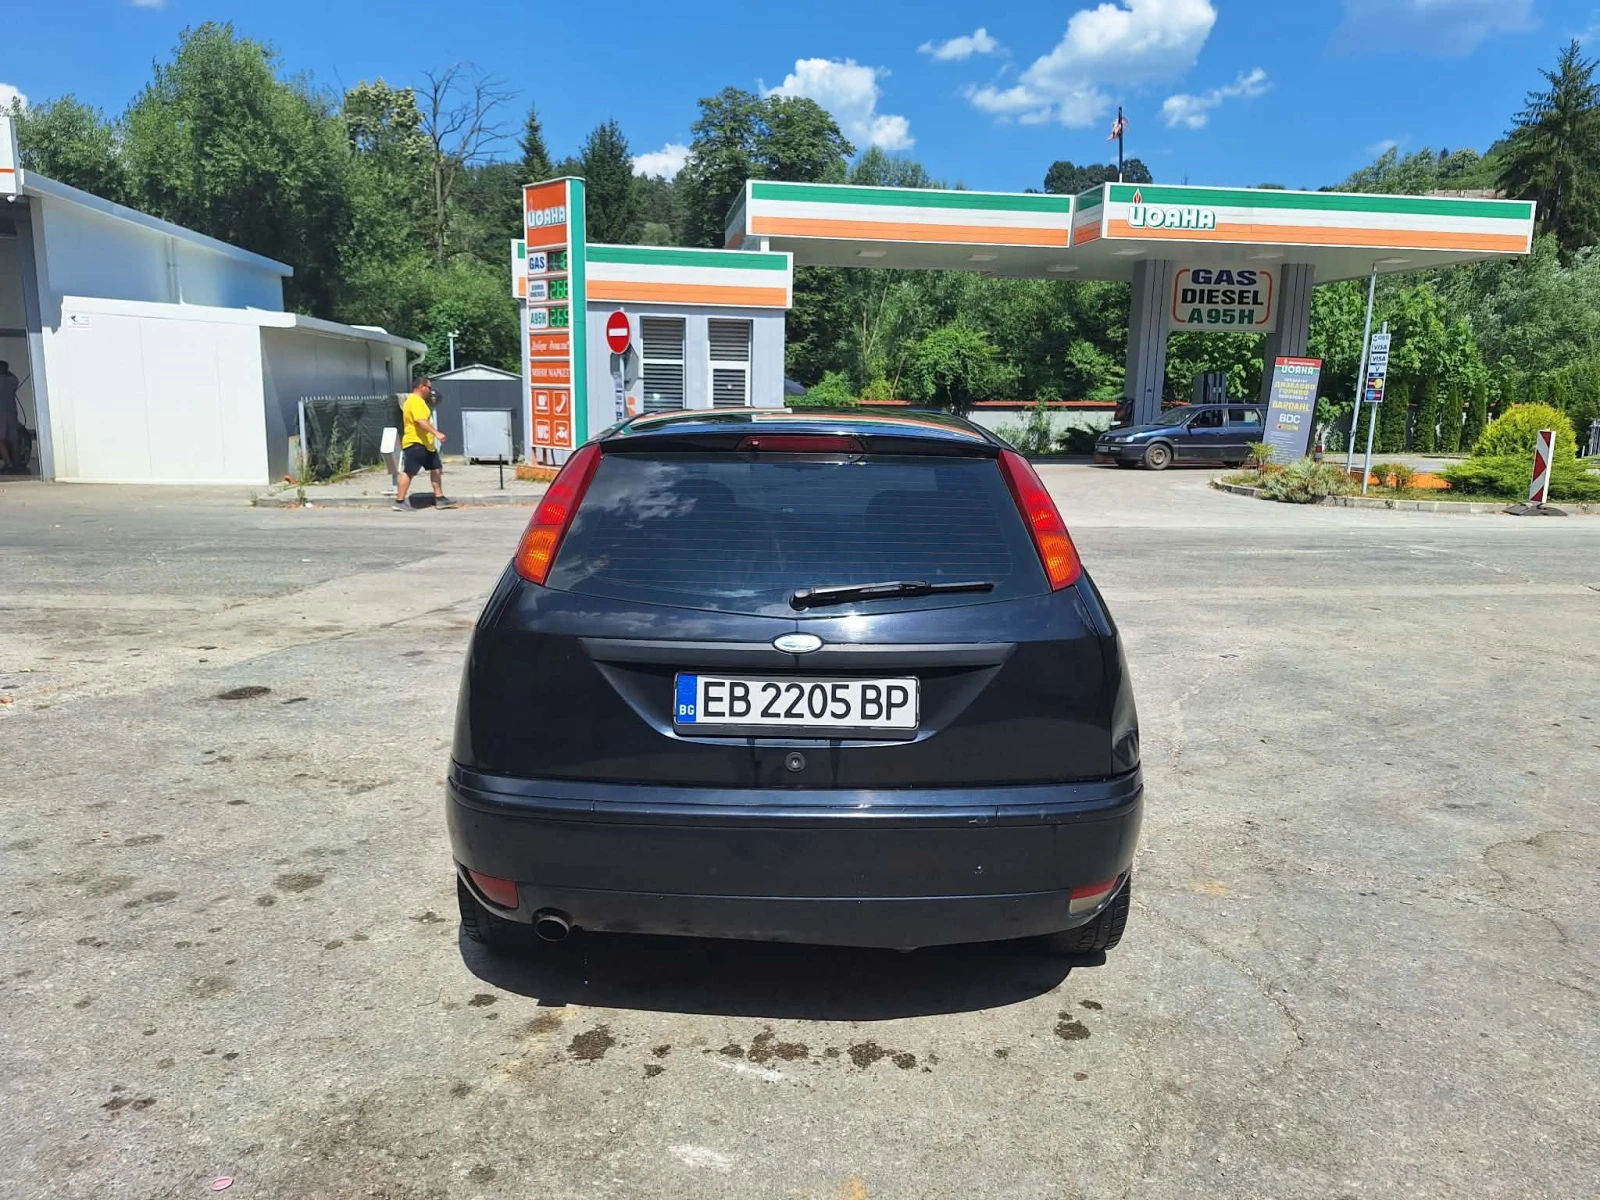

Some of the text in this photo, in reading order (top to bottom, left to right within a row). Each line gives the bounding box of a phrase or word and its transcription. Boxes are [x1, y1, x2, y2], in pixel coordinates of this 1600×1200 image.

[529, 256, 545, 270] GAS
[1191, 269, 1257, 286] GAS
[1181, 288, 1264, 305] DIESEL
[703, 682, 909, 720] EB 2205 BP
[679, 705, 695, 716] BG
